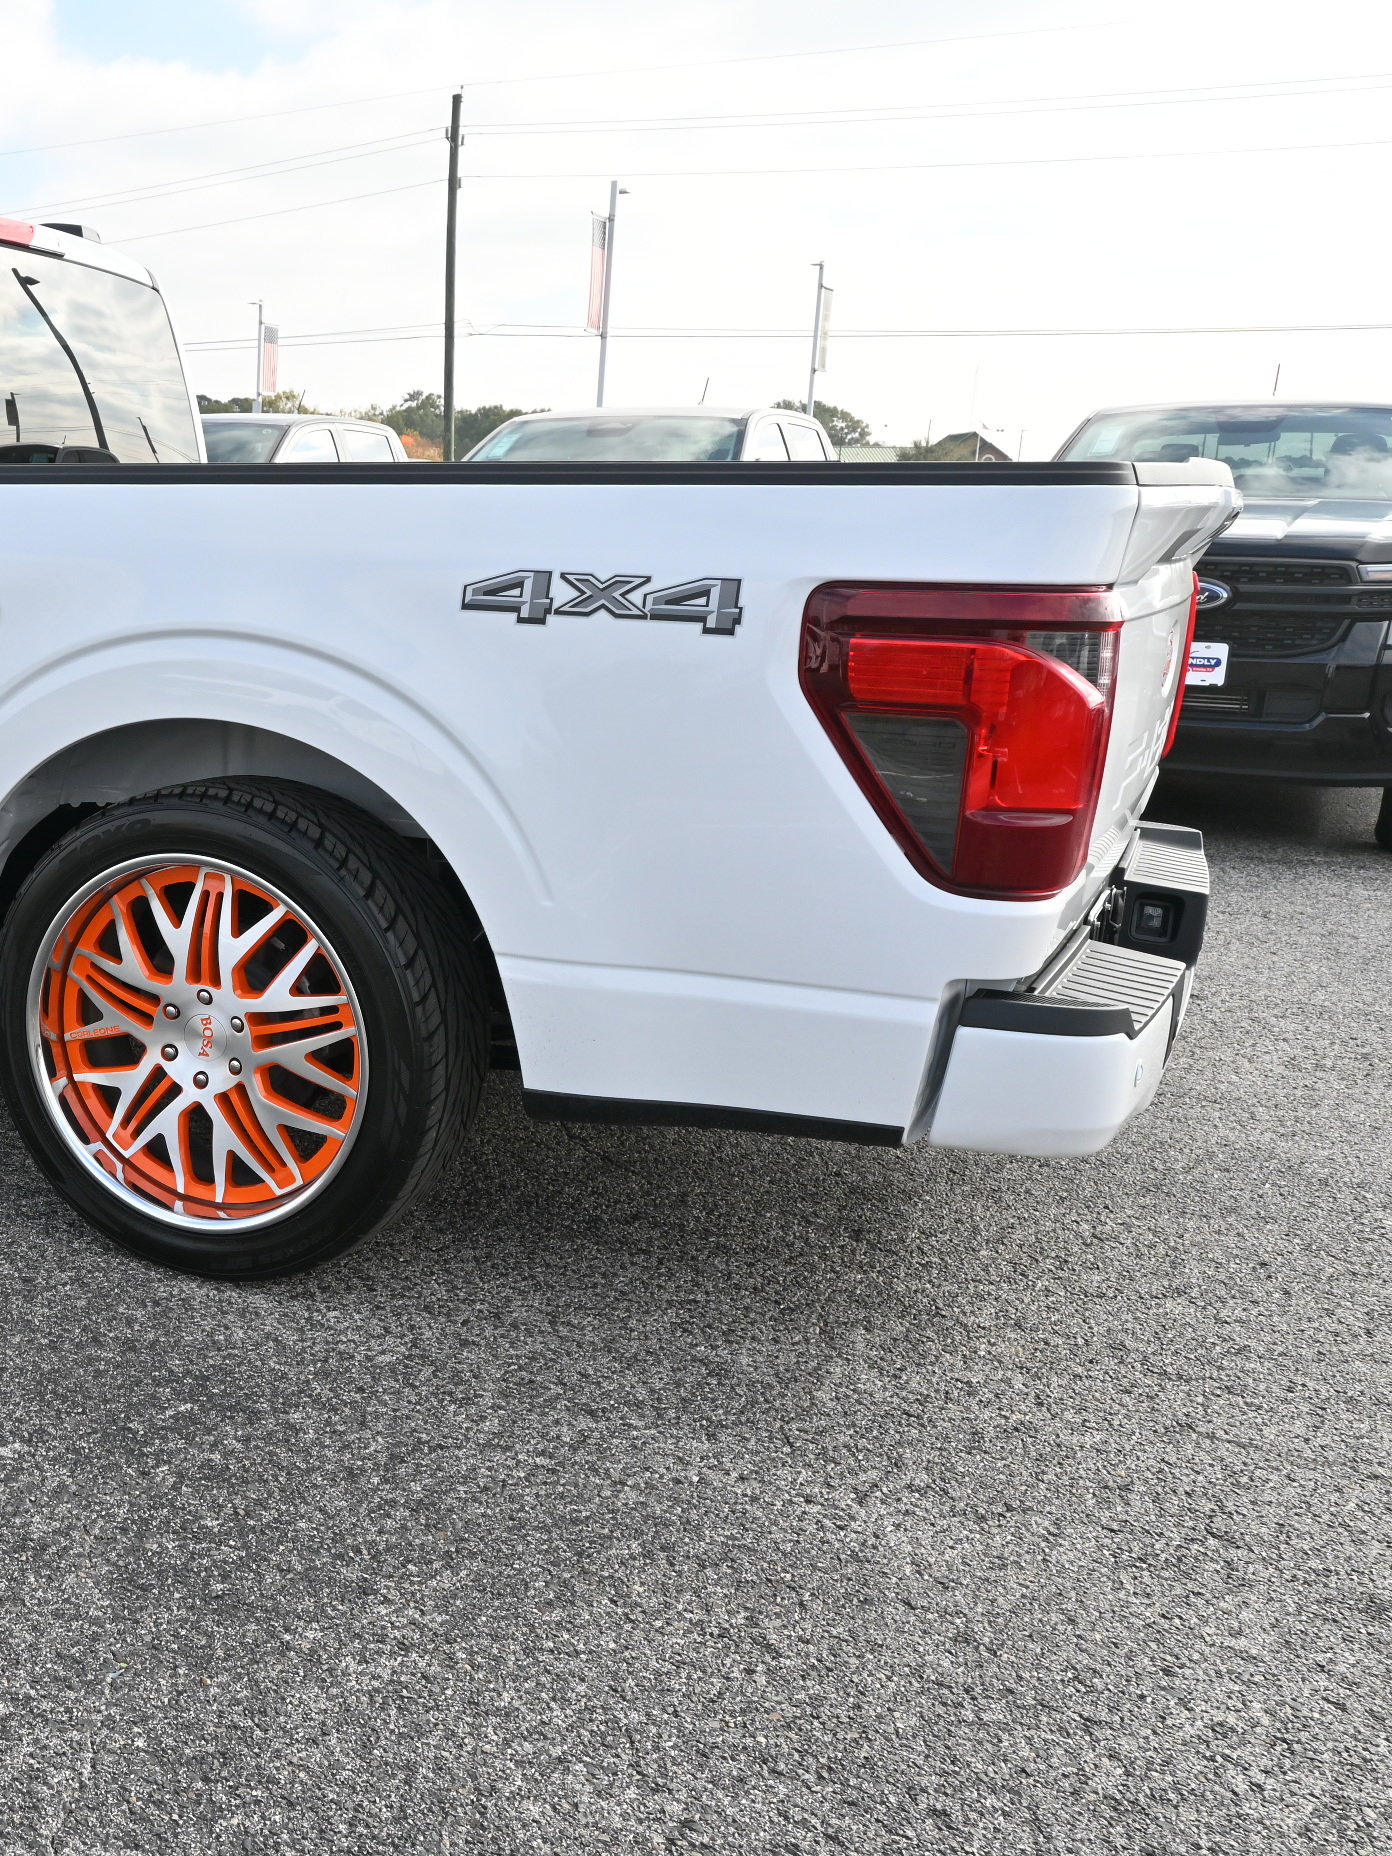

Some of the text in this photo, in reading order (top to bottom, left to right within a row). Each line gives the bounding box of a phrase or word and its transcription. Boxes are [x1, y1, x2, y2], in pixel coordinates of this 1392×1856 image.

[460, 569, 743, 637] 4X4
[1189, 658, 1218, 666] NDLY
[198, 1016, 215, 1057] BOSA
